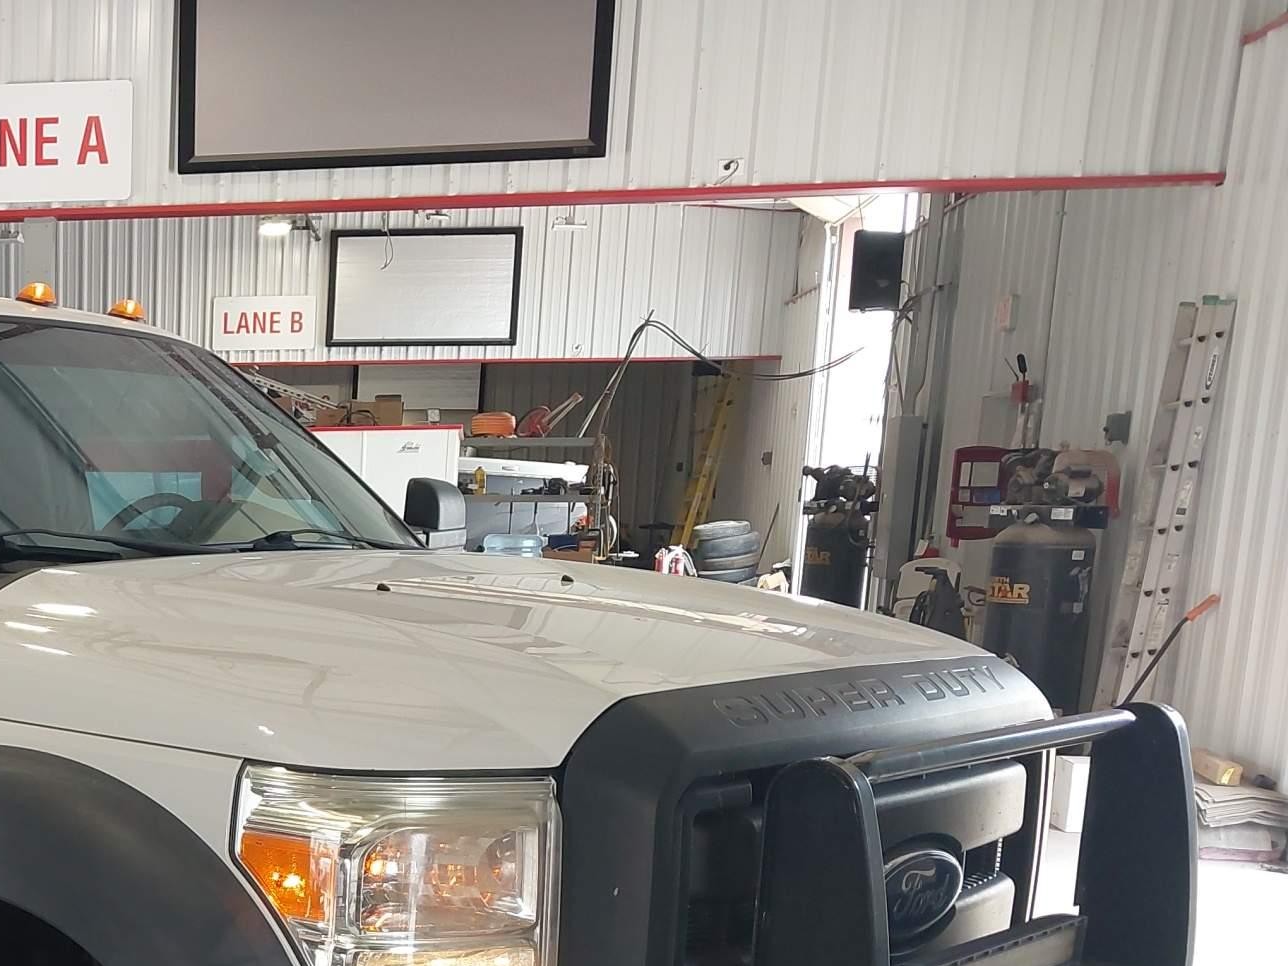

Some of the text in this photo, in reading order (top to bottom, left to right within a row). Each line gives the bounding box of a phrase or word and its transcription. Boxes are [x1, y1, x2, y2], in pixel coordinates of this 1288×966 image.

[76, 115, 109, 165] A
[222, 311, 304, 335] LANE B
[712, 664, 1007, 729] SUPER DUTY
[892, 867, 952, 915] Ford
